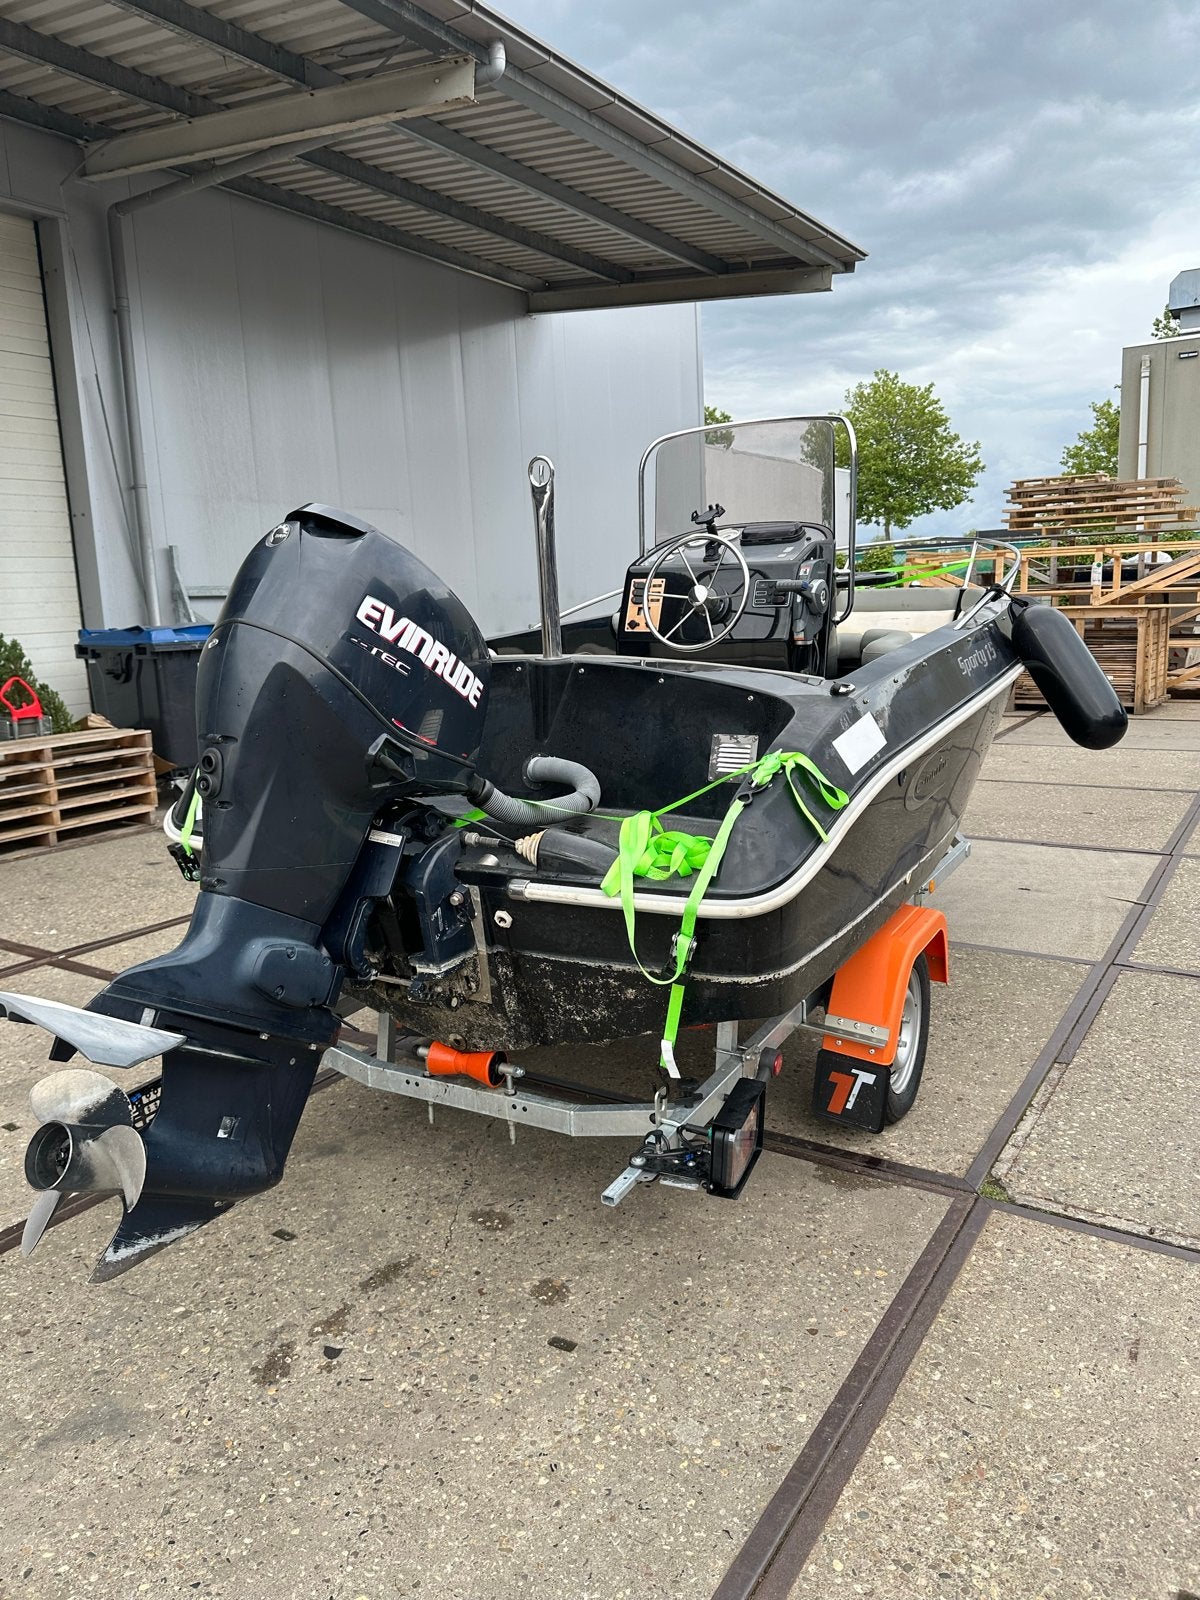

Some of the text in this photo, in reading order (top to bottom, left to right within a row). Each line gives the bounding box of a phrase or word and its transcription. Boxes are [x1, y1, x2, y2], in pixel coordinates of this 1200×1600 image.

[356, 595, 484, 709] EVINRUDE
[957, 641, 997, 677] Sporty 15
